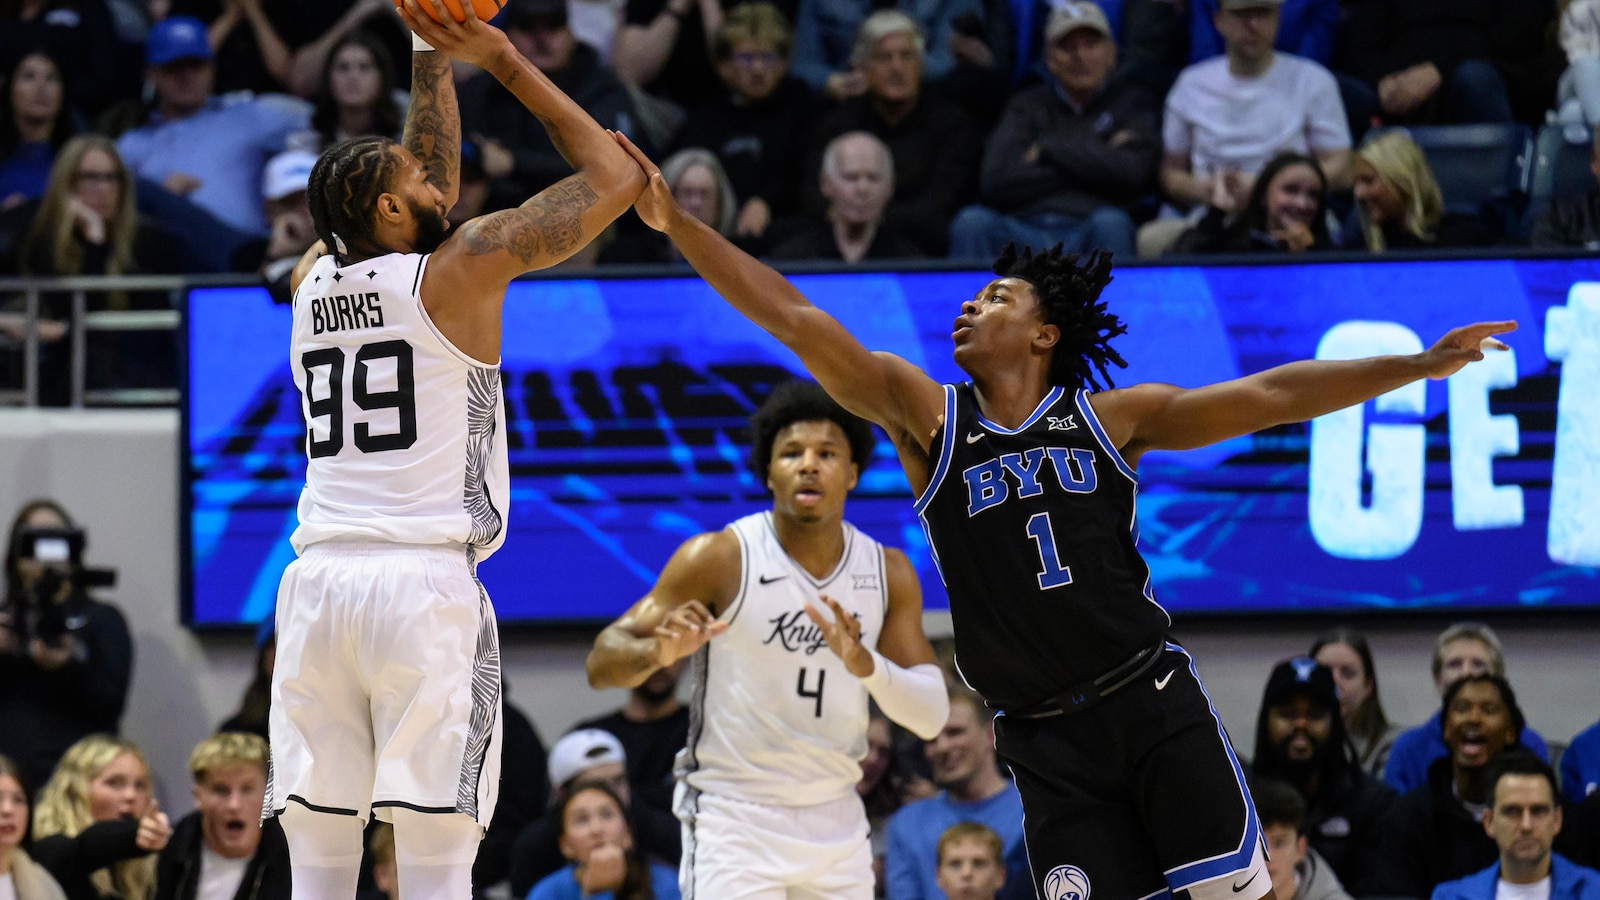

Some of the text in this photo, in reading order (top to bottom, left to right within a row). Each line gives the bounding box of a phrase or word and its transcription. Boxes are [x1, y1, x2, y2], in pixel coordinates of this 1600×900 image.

[311, 292, 384, 335] BURKS
[302, 340, 417, 459] 99
[963, 447, 1098, 518] BYU
[1026, 511, 1073, 590] 1
[762, 609, 867, 656] Knig
[796, 667, 825, 718] 4
